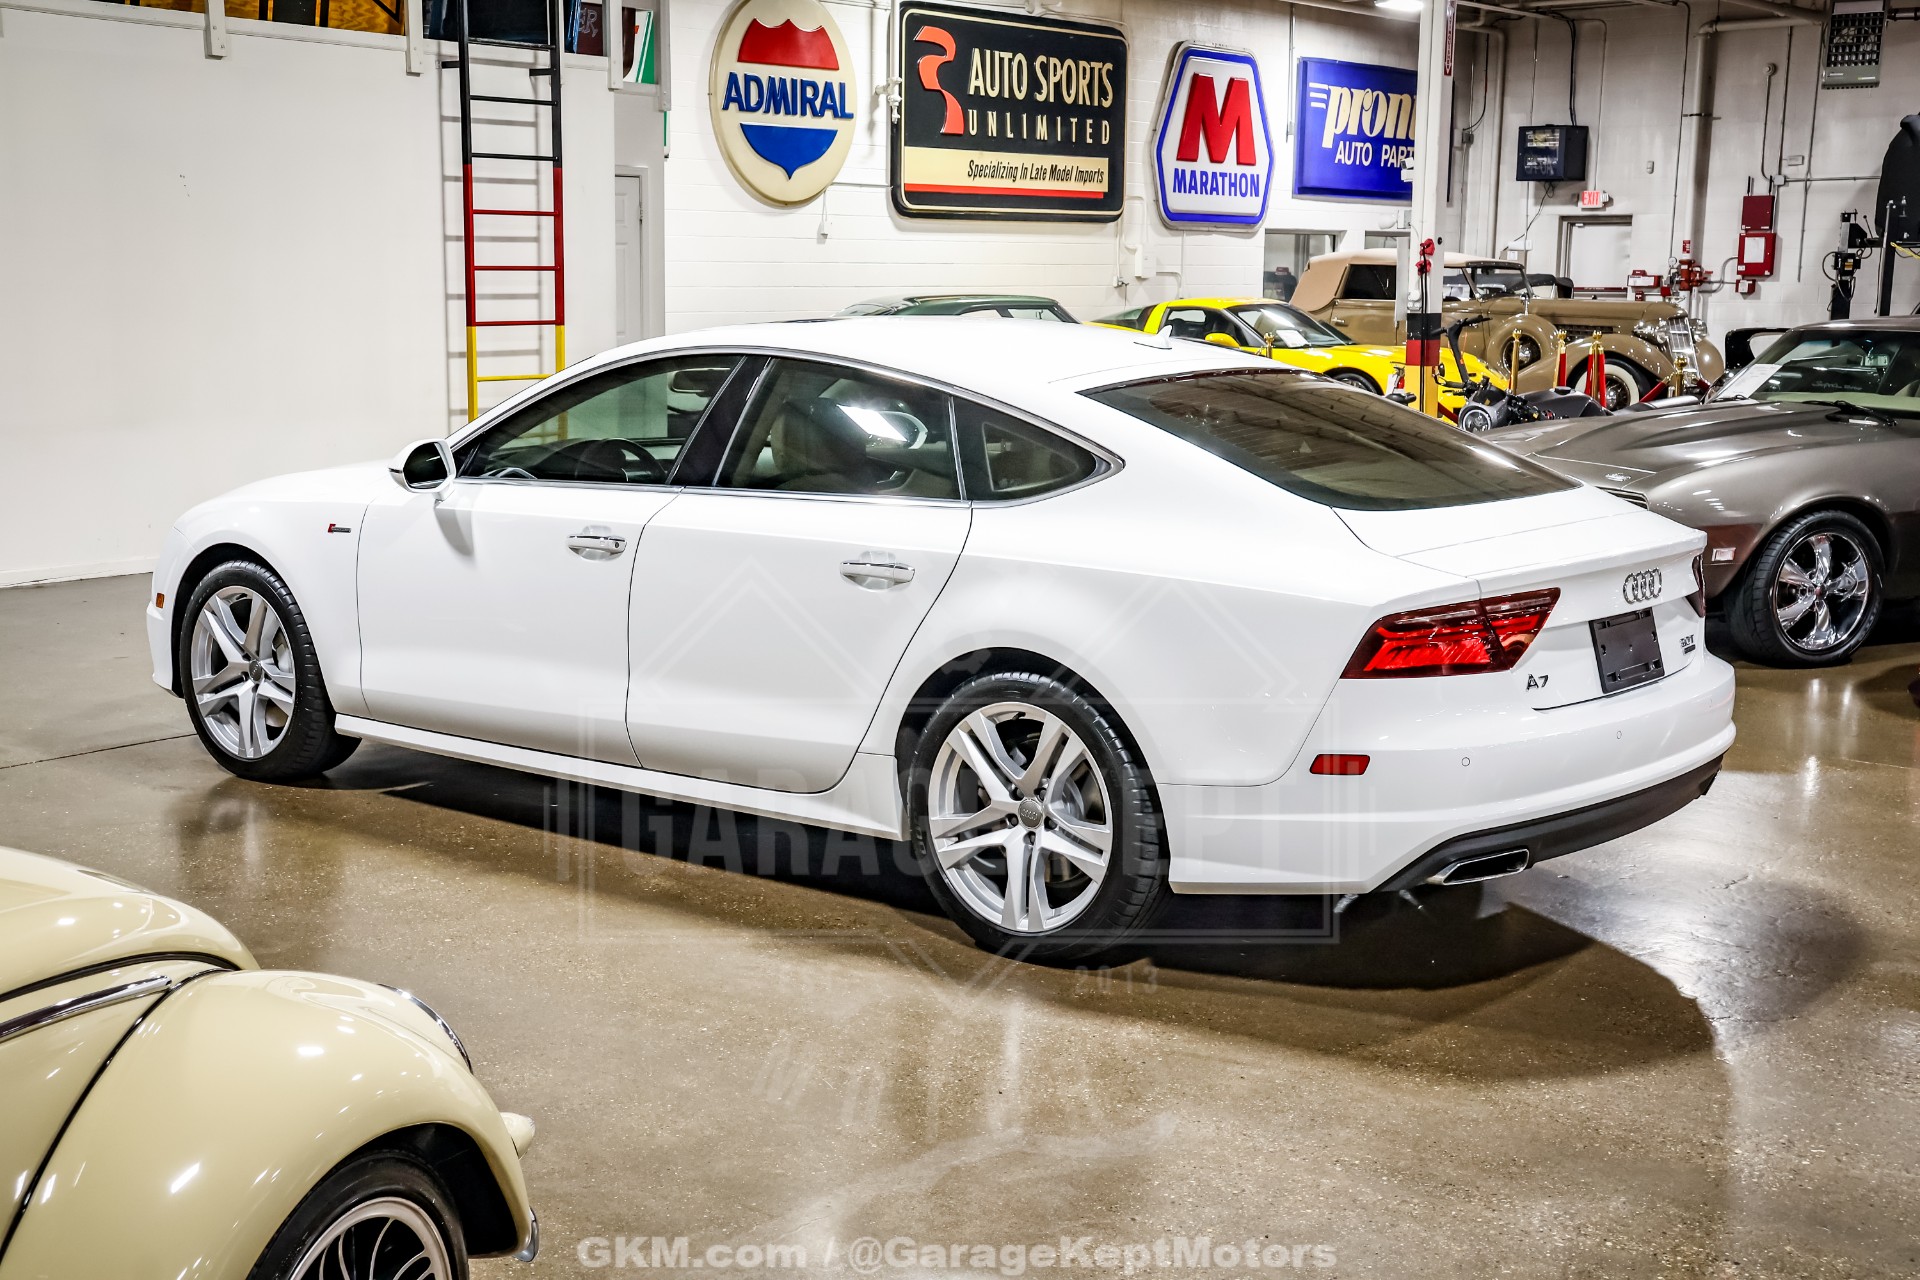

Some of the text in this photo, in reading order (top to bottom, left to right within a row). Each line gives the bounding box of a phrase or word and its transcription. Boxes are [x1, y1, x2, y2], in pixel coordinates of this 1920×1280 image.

[967, 48, 1114, 108] AUTO SPORTS
[722, 71, 854, 119] ADMIRAL
[968, 109, 1110, 145] UNLIMITED
[1176, 73, 1256, 166] M
[1335, 141, 1373, 167] AUTO
[967, 159, 1104, 186] Specializing In Late Model Imports
[1173, 168, 1260, 198] MARATHON
[1582, 191, 1600, 206] EXIT
[1526, 674, 1549, 690] A7
